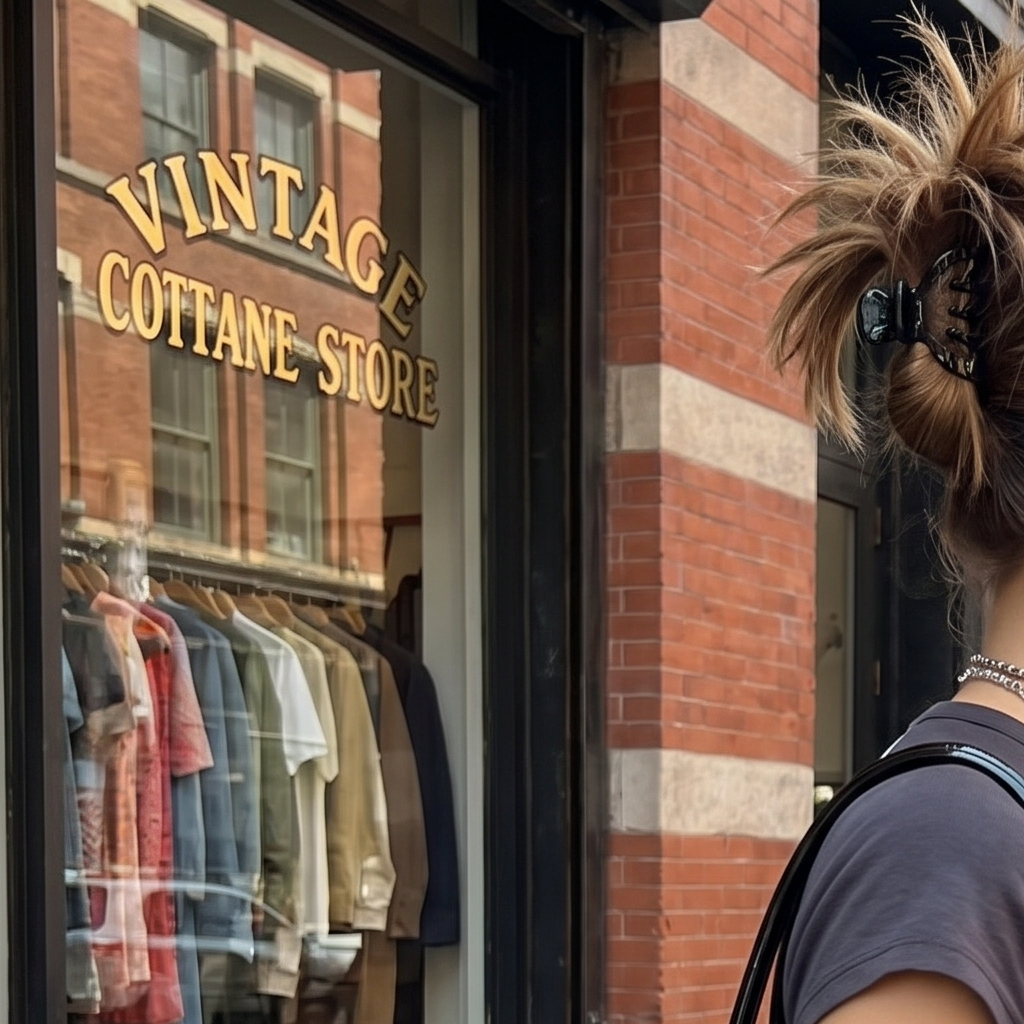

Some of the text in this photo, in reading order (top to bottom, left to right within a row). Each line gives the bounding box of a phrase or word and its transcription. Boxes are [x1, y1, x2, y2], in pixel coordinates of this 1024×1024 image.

[105, 151, 427, 338] VINTAGE
[98, 251, 440, 428] COTTANE STORE
